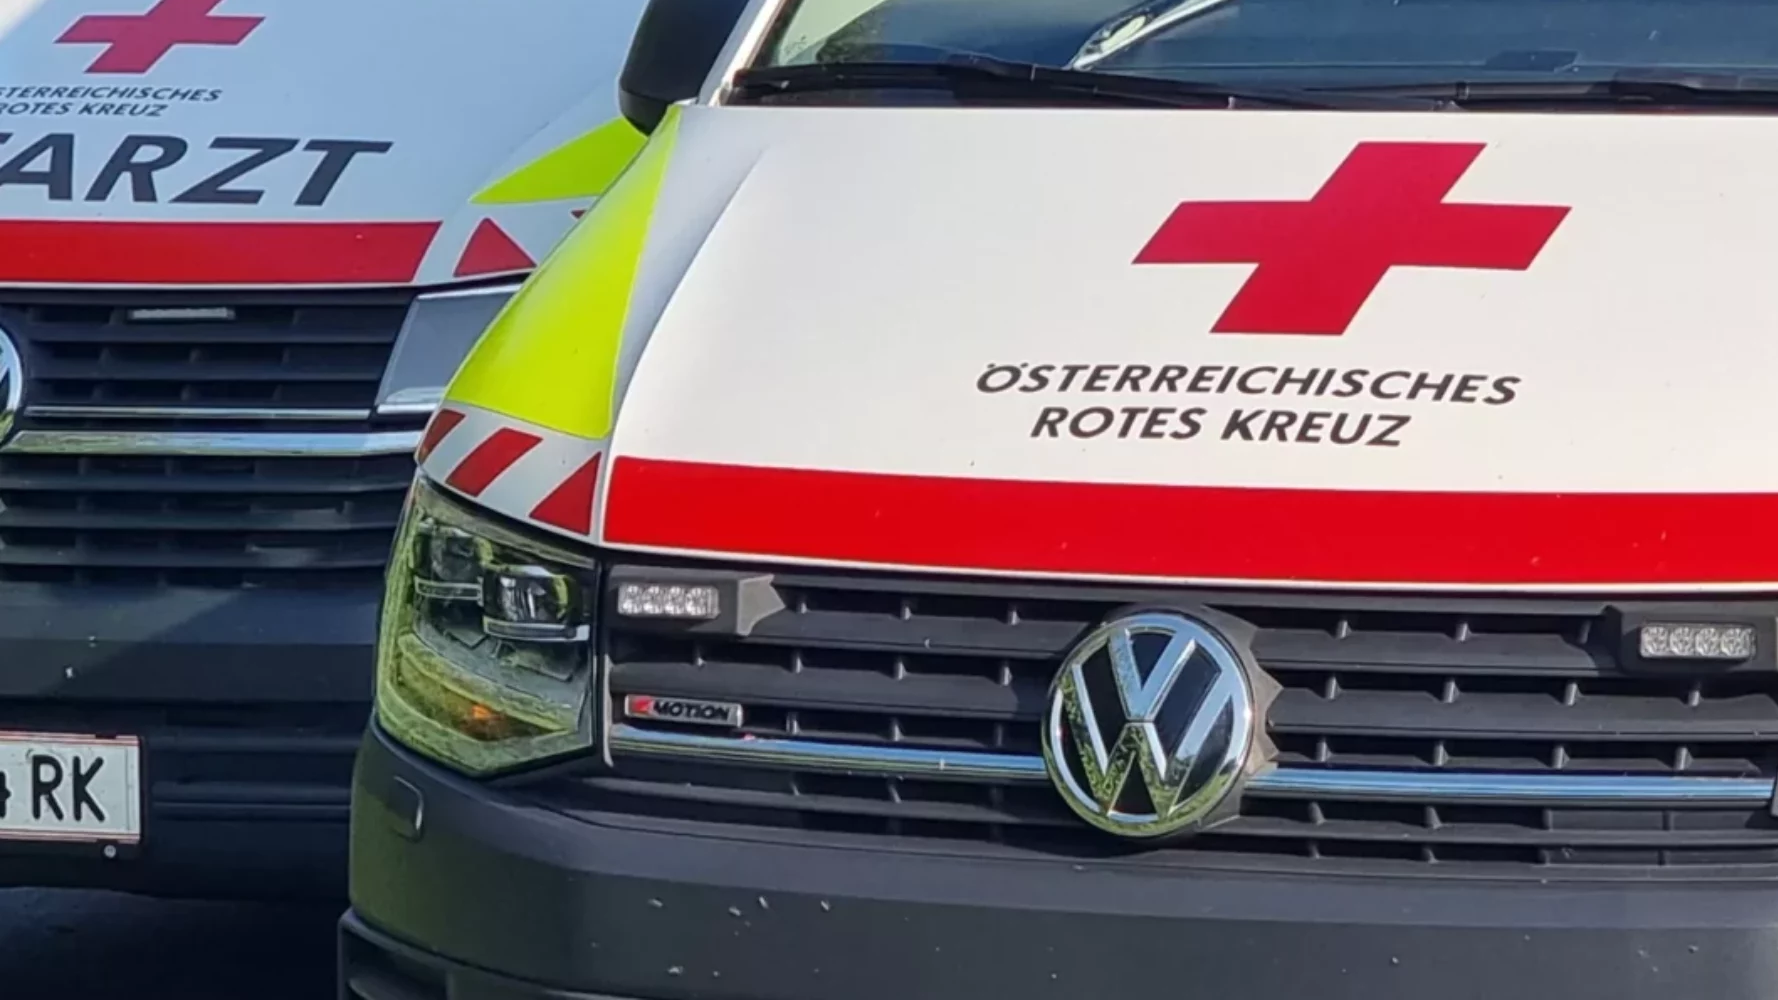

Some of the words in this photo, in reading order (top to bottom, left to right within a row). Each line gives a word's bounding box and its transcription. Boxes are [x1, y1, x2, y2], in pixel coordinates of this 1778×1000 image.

[78, 102, 169, 117] KREUZ
[0, 132, 395, 207] ARZT
[976, 362, 1523, 406] ÖSTERREICHISCHES
[1030, 406, 1208, 440] ROTES
[1220, 409, 1412, 447] KREUZ
[32, 753, 106, 823] RK
